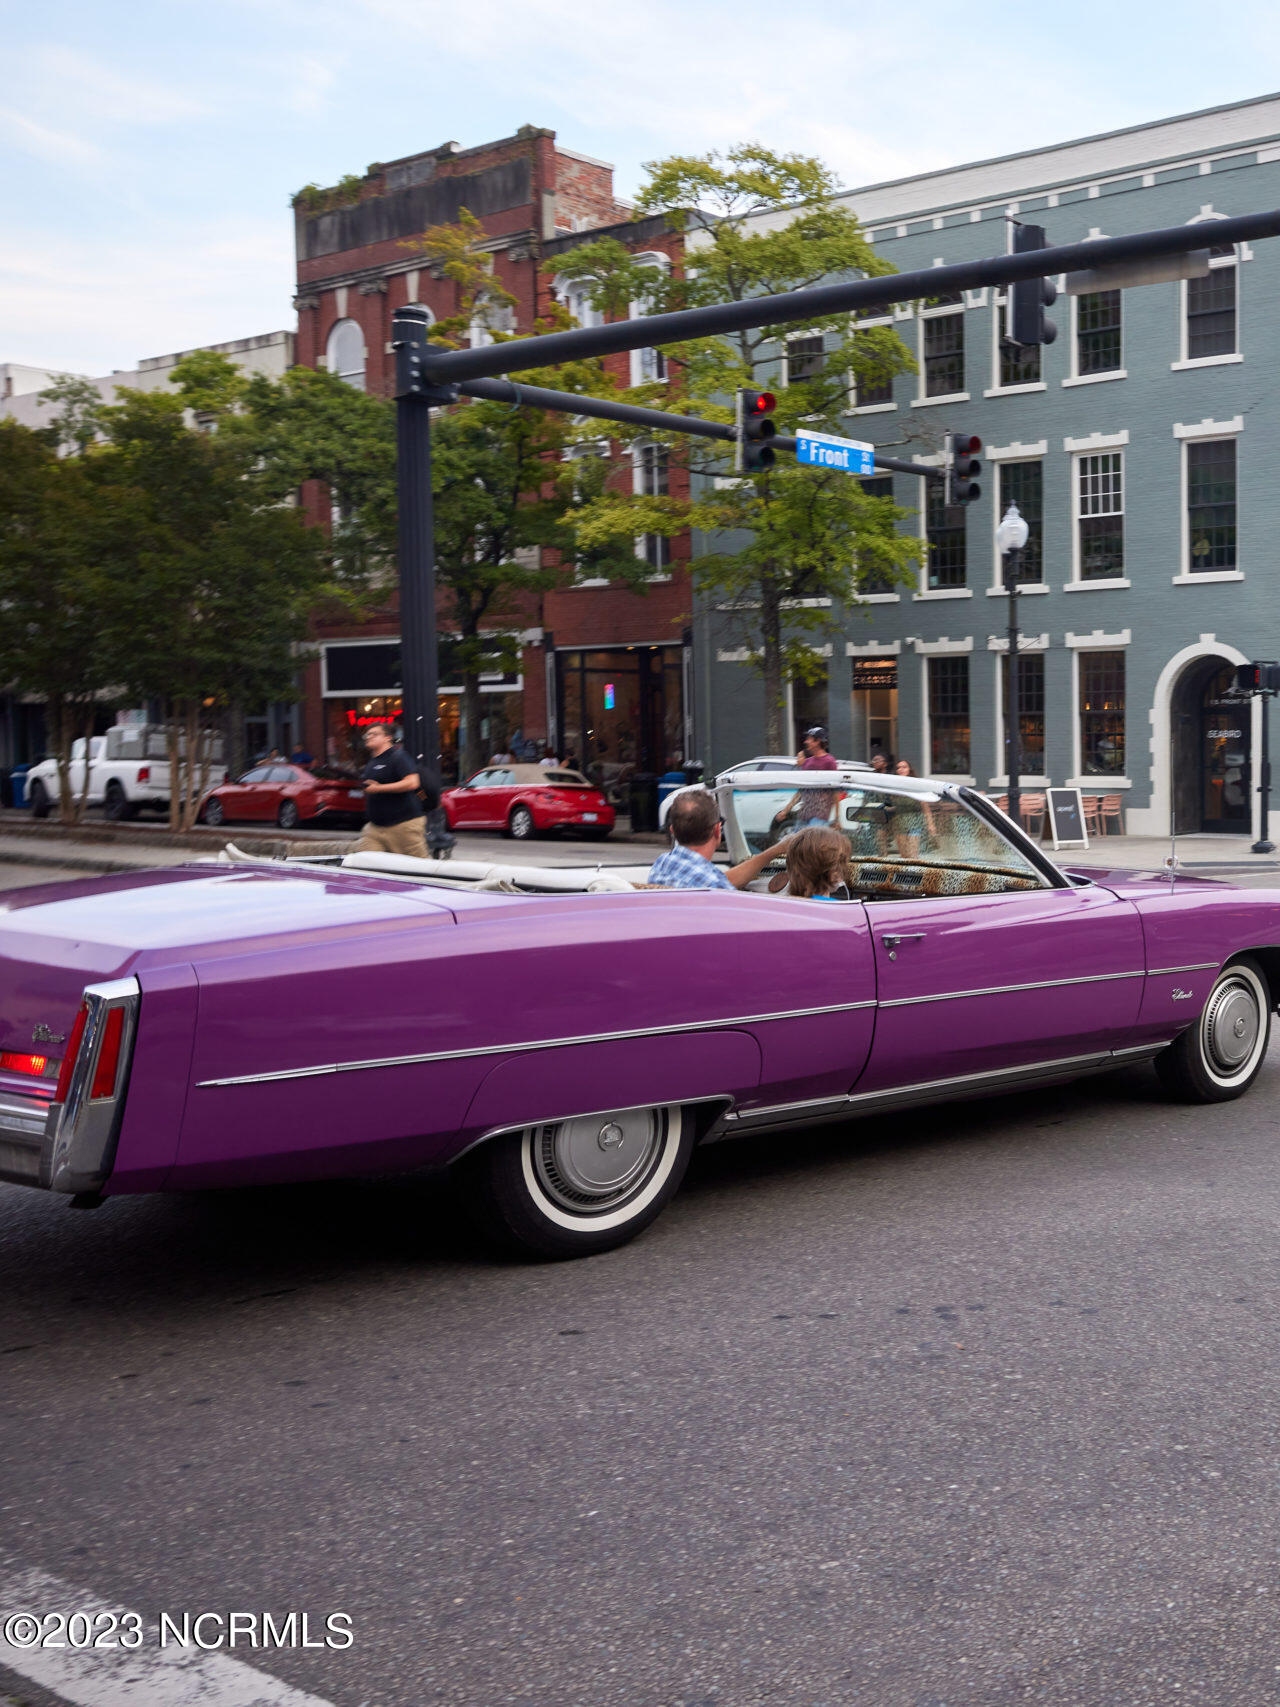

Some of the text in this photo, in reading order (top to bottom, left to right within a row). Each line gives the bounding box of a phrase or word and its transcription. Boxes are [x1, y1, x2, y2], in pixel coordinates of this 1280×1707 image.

[800, 439, 808, 450] S
[809, 442, 850, 468] Front
[1207, 730, 1242, 738] SEABIRD
